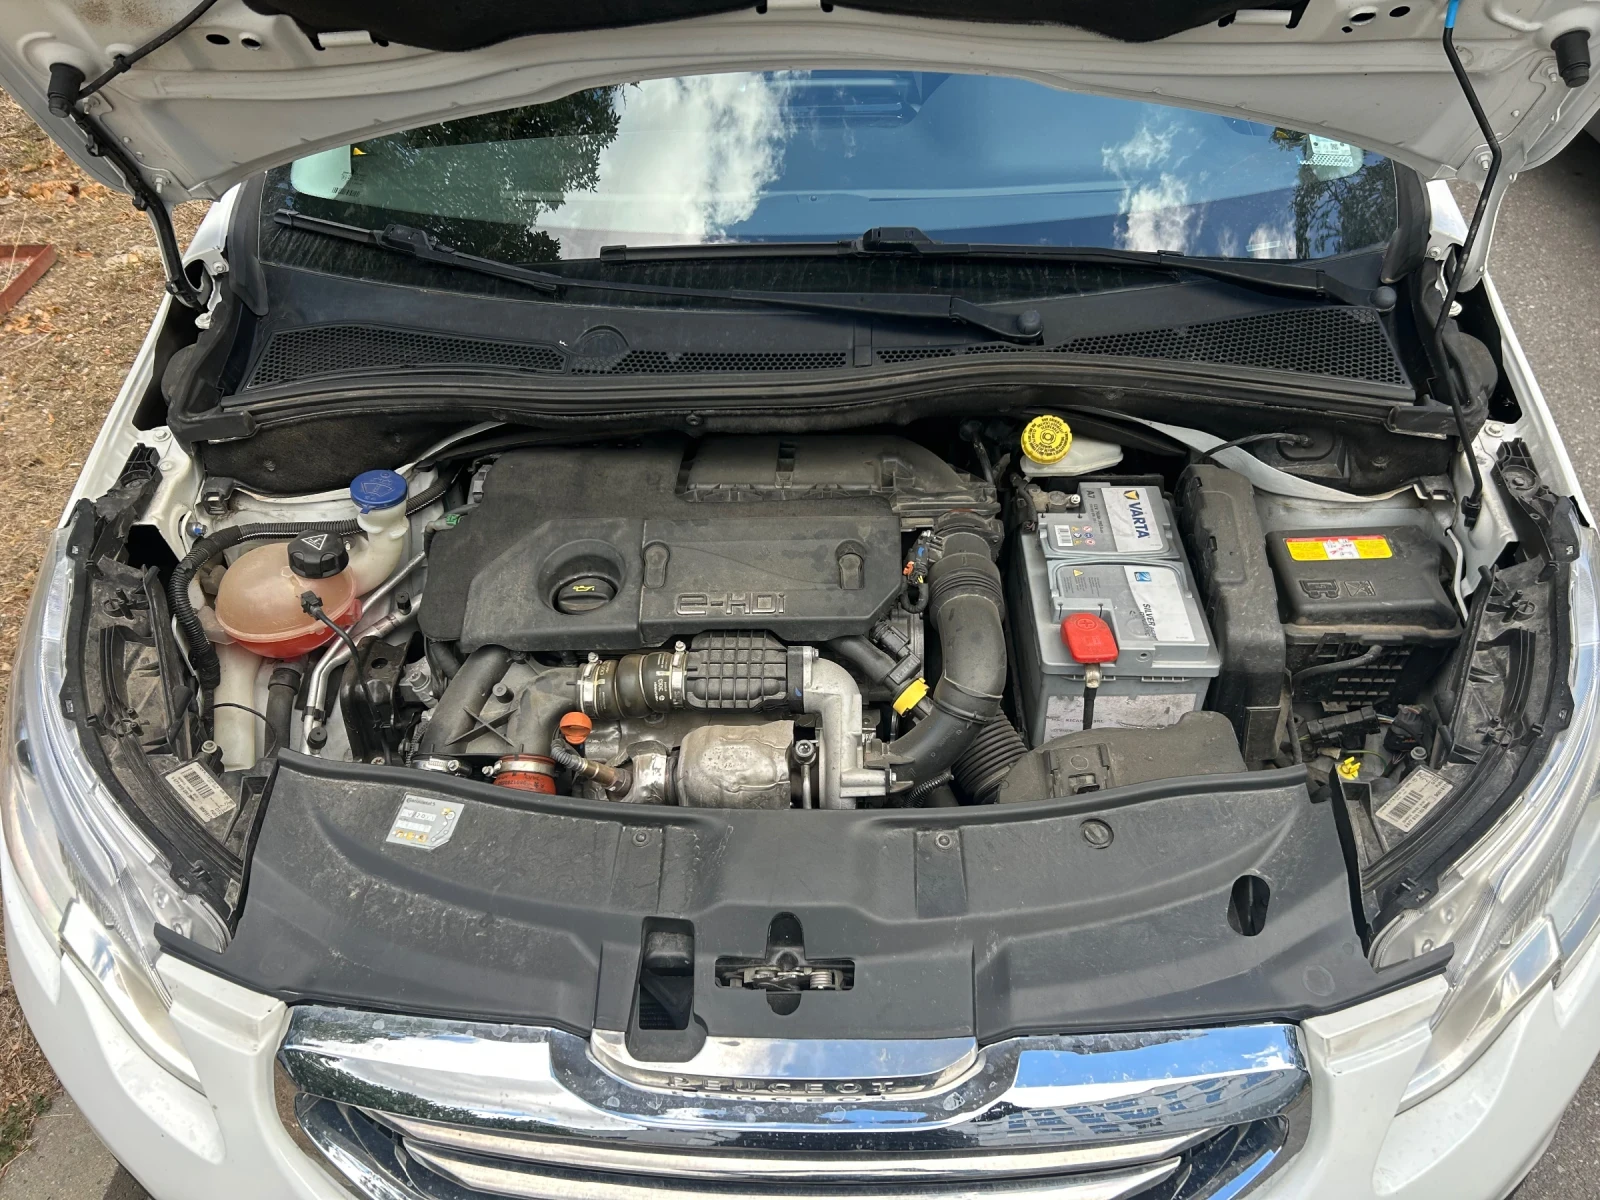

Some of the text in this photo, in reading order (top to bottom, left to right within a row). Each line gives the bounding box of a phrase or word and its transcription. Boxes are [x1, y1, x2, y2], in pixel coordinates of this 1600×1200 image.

[1086, 490, 1095, 499] A7
[1128, 501, 1150, 539] VARTA
[1142, 603, 1156, 627] SILVER
[667, 1075, 895, 1095] PEUGEOT
